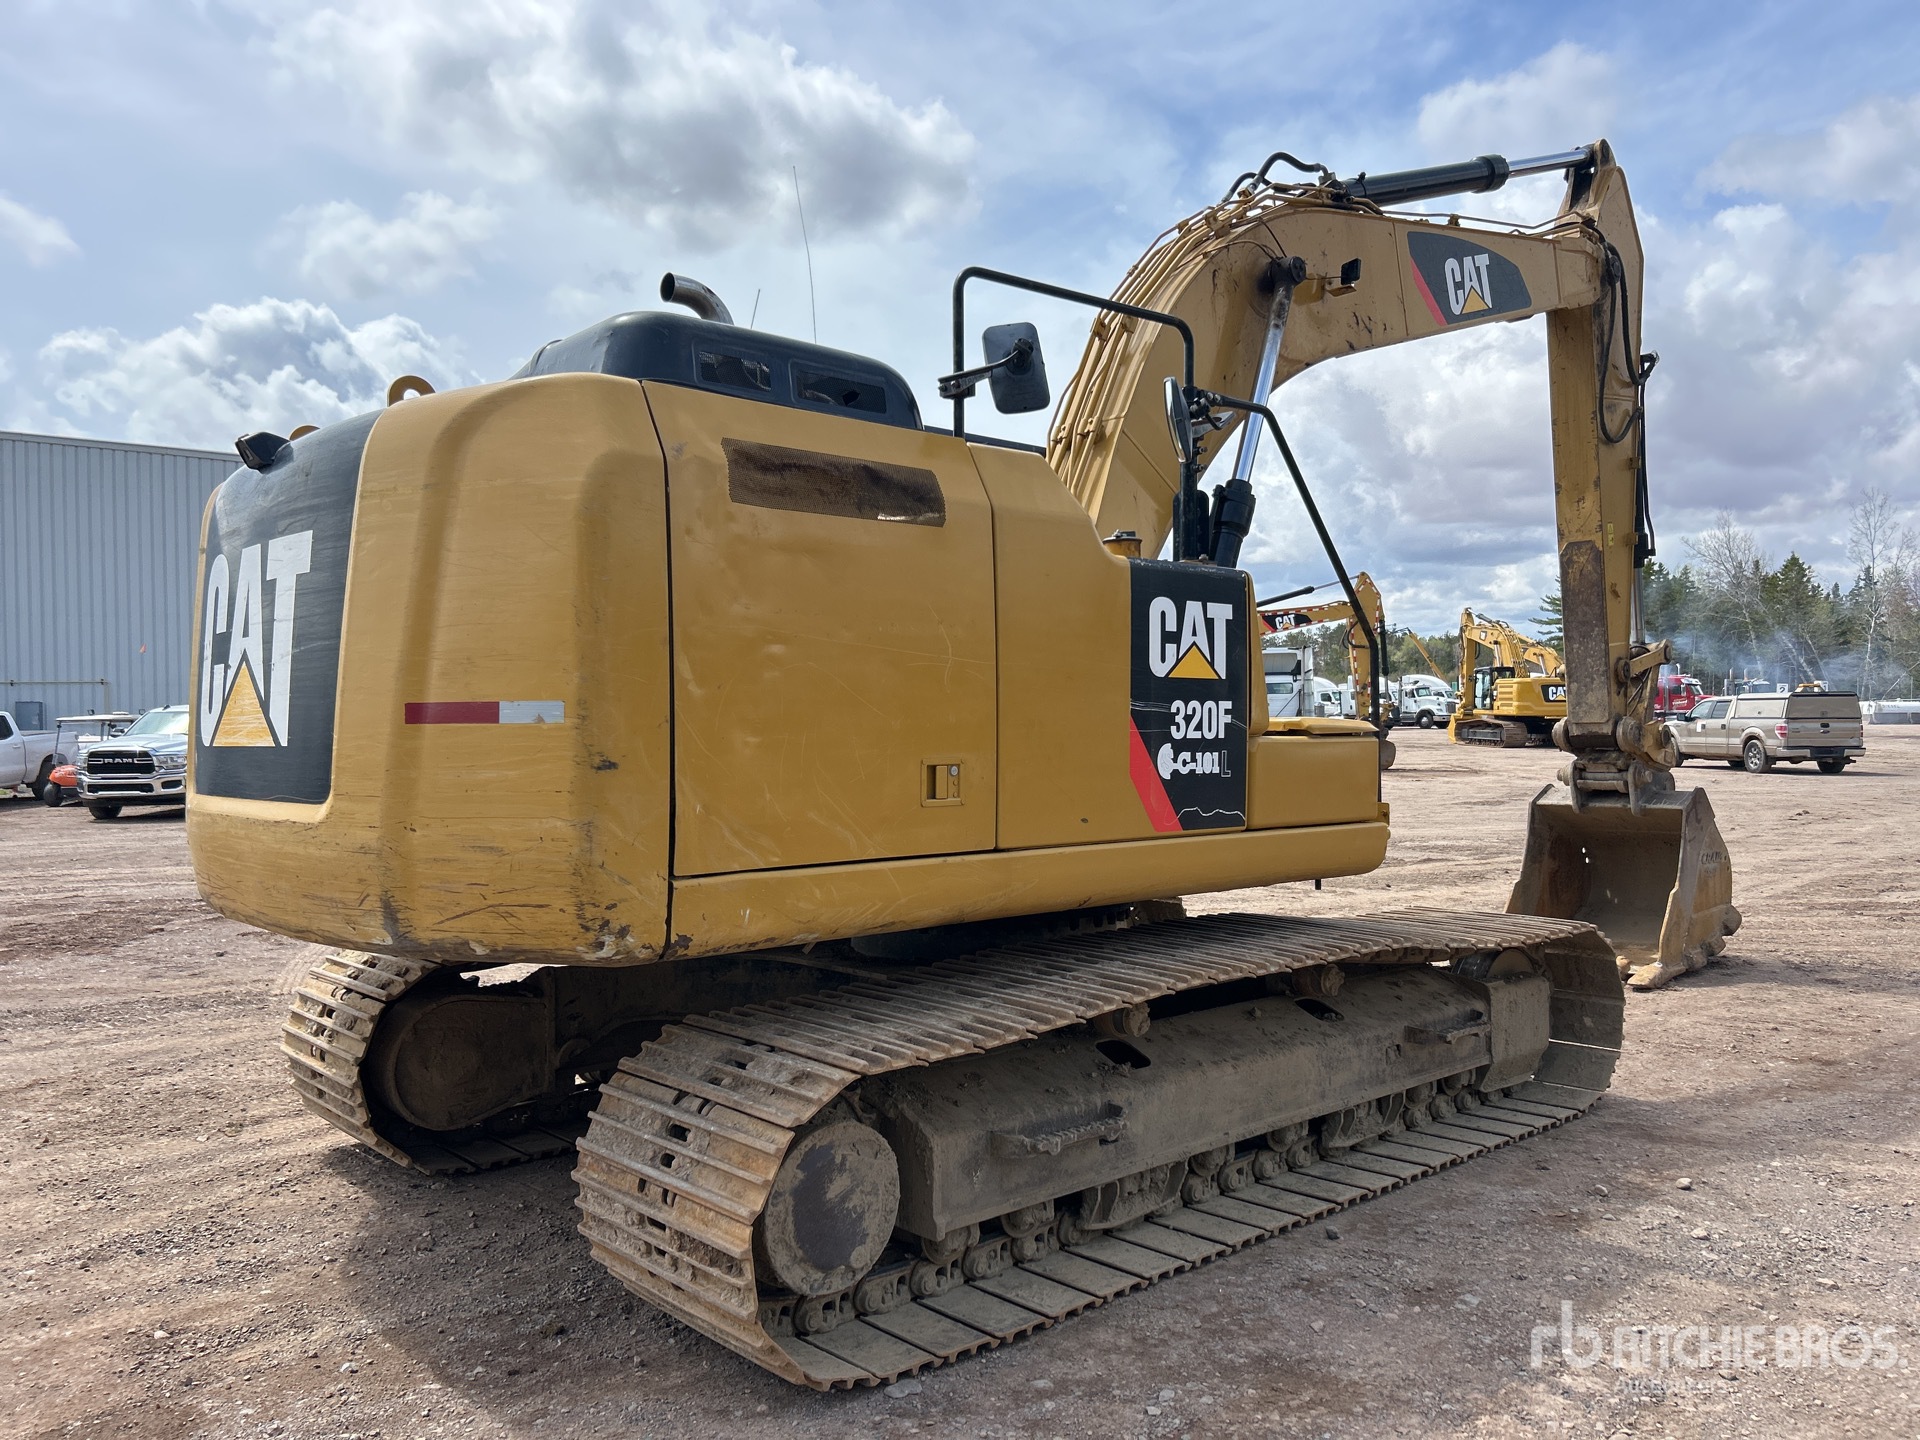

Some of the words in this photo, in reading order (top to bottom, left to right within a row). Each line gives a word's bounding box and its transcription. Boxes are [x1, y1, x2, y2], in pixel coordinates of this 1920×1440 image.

[1444, 253, 1493, 315] CAT
[200, 529, 313, 748] CAT
[1149, 596, 1233, 679] CAT
[1275, 614, 1295, 630] CAT
[1548, 686, 1567, 701] CA
[1170, 699, 1233, 740] 320F
